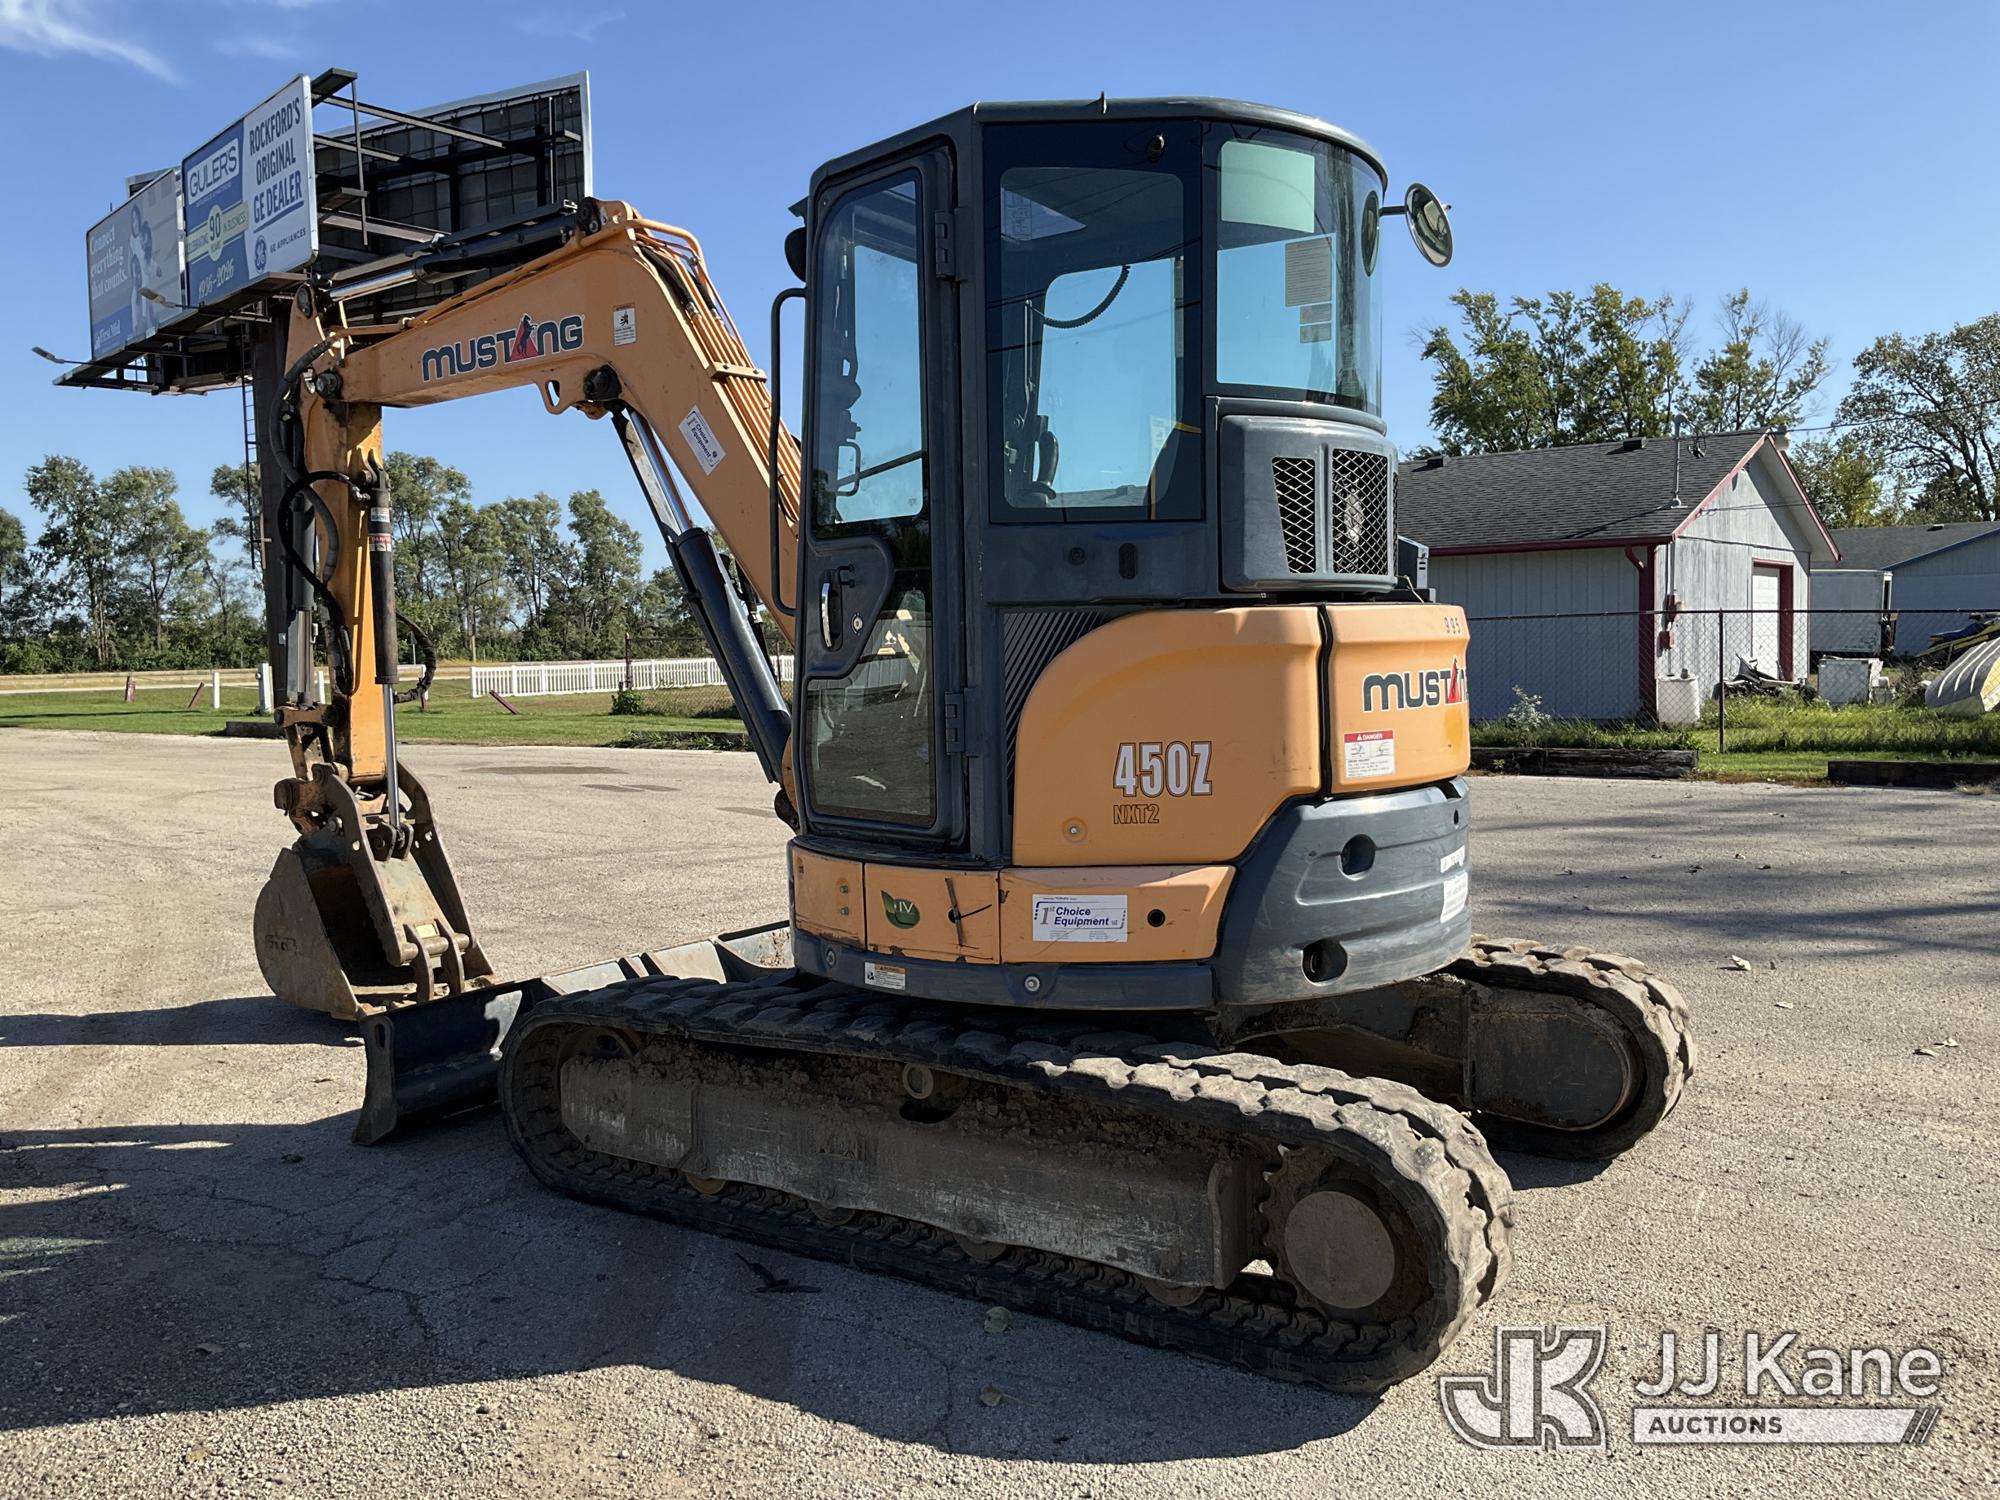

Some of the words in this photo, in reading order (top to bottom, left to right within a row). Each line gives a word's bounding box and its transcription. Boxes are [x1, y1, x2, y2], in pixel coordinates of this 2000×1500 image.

[249, 97, 301, 156] ROCKFORD'S
[256, 137, 297, 186] ORIGINAL
[254, 191, 265, 223] GE
[266, 169, 302, 217] DEALER
[210, 212, 221, 241] 90
[277, 228, 306, 249] APPLIANCES
[421, 313, 584, 382] MUSTANG
[1113, 741, 1213, 798] 450Z
[1113, 803, 1160, 825] NXT2
[1054, 916, 1110, 928] Equipment
[1055, 906, 1092, 916] Choice
